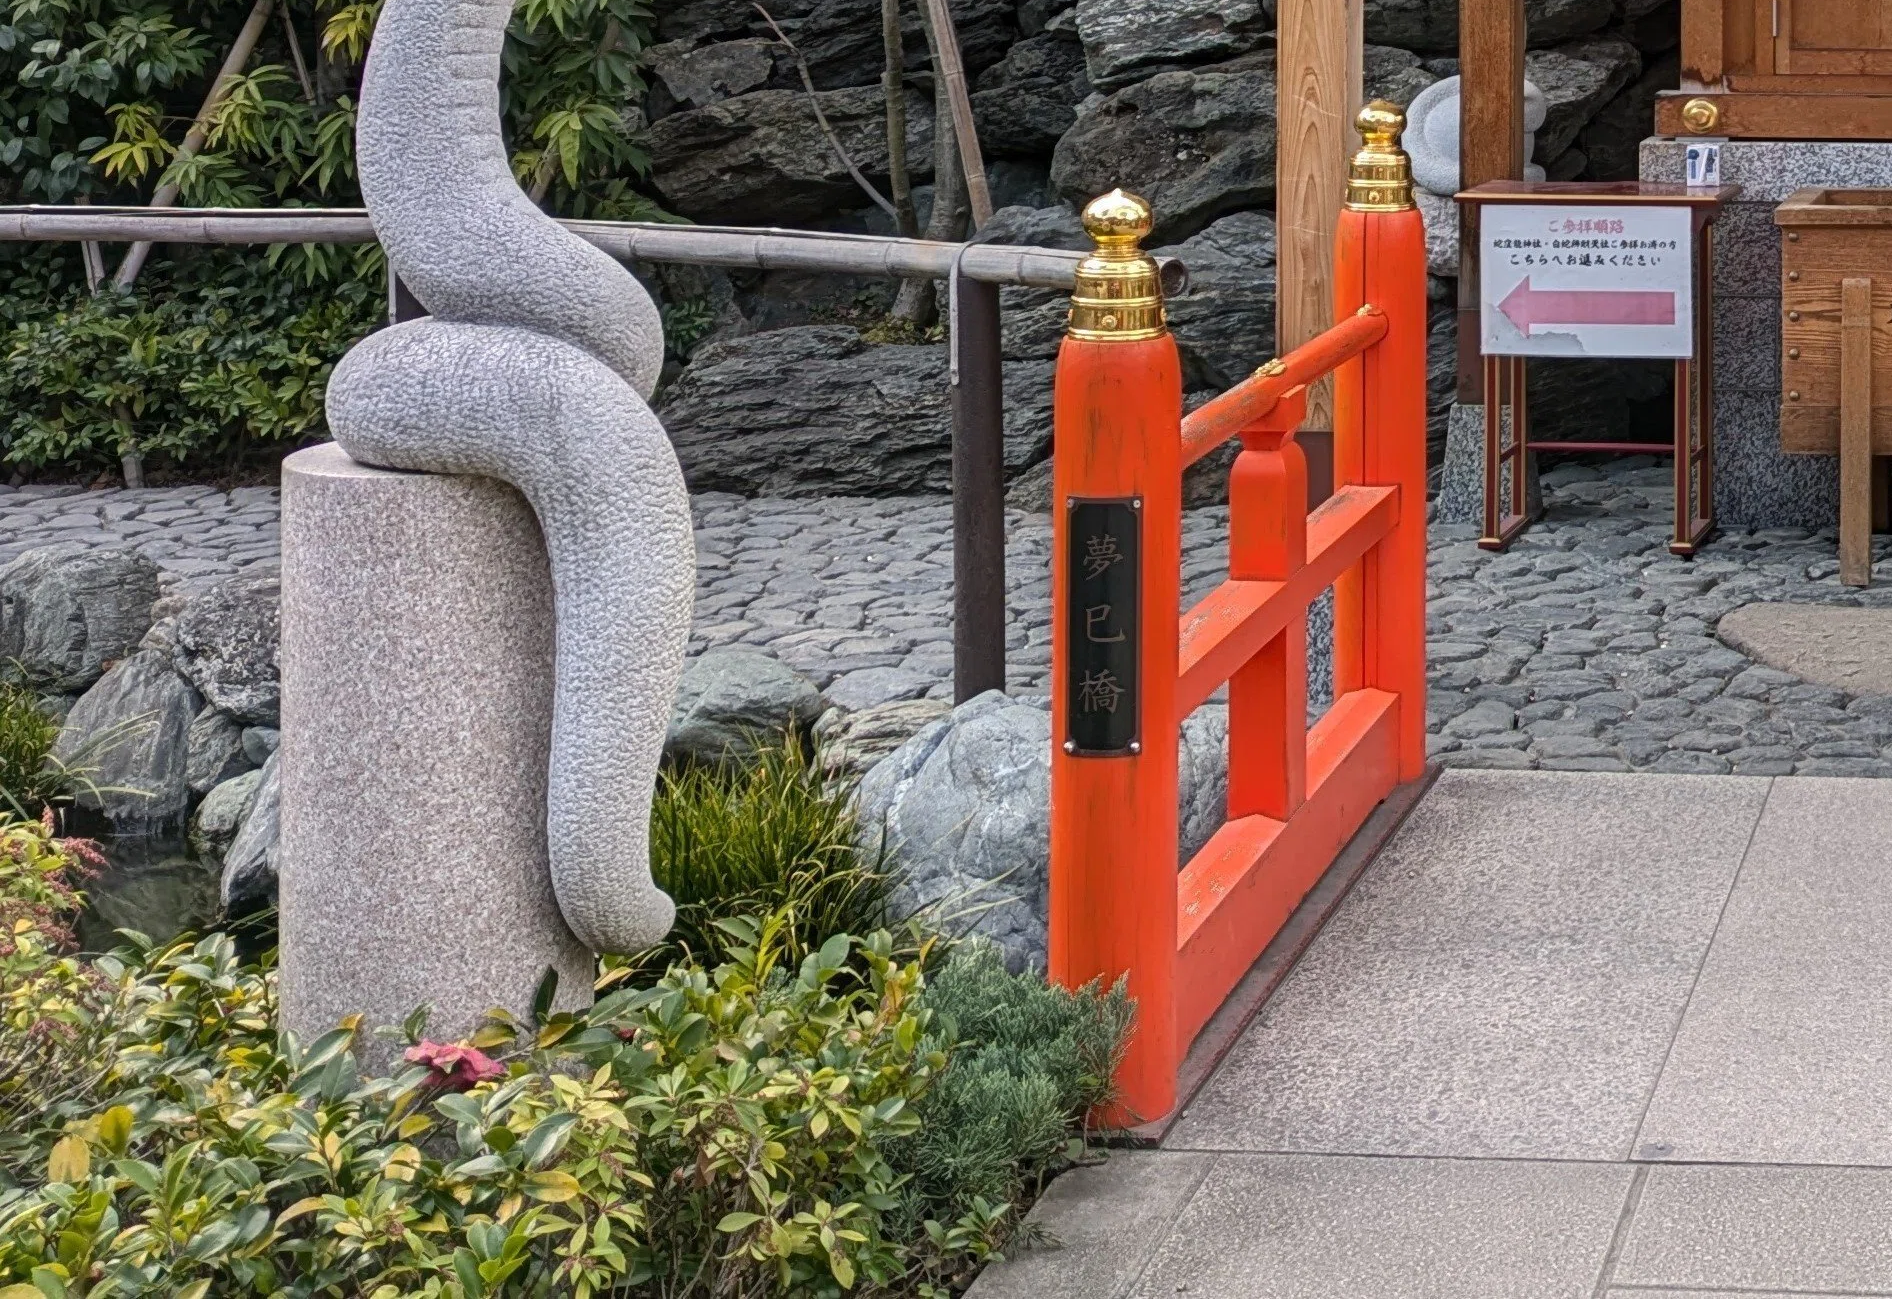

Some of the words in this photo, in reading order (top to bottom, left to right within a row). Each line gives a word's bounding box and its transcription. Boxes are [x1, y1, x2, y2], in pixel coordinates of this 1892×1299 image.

[1510, 254, 1661, 266] こちらへお進みください
[1079, 533, 1125, 713] 夢巳橋
